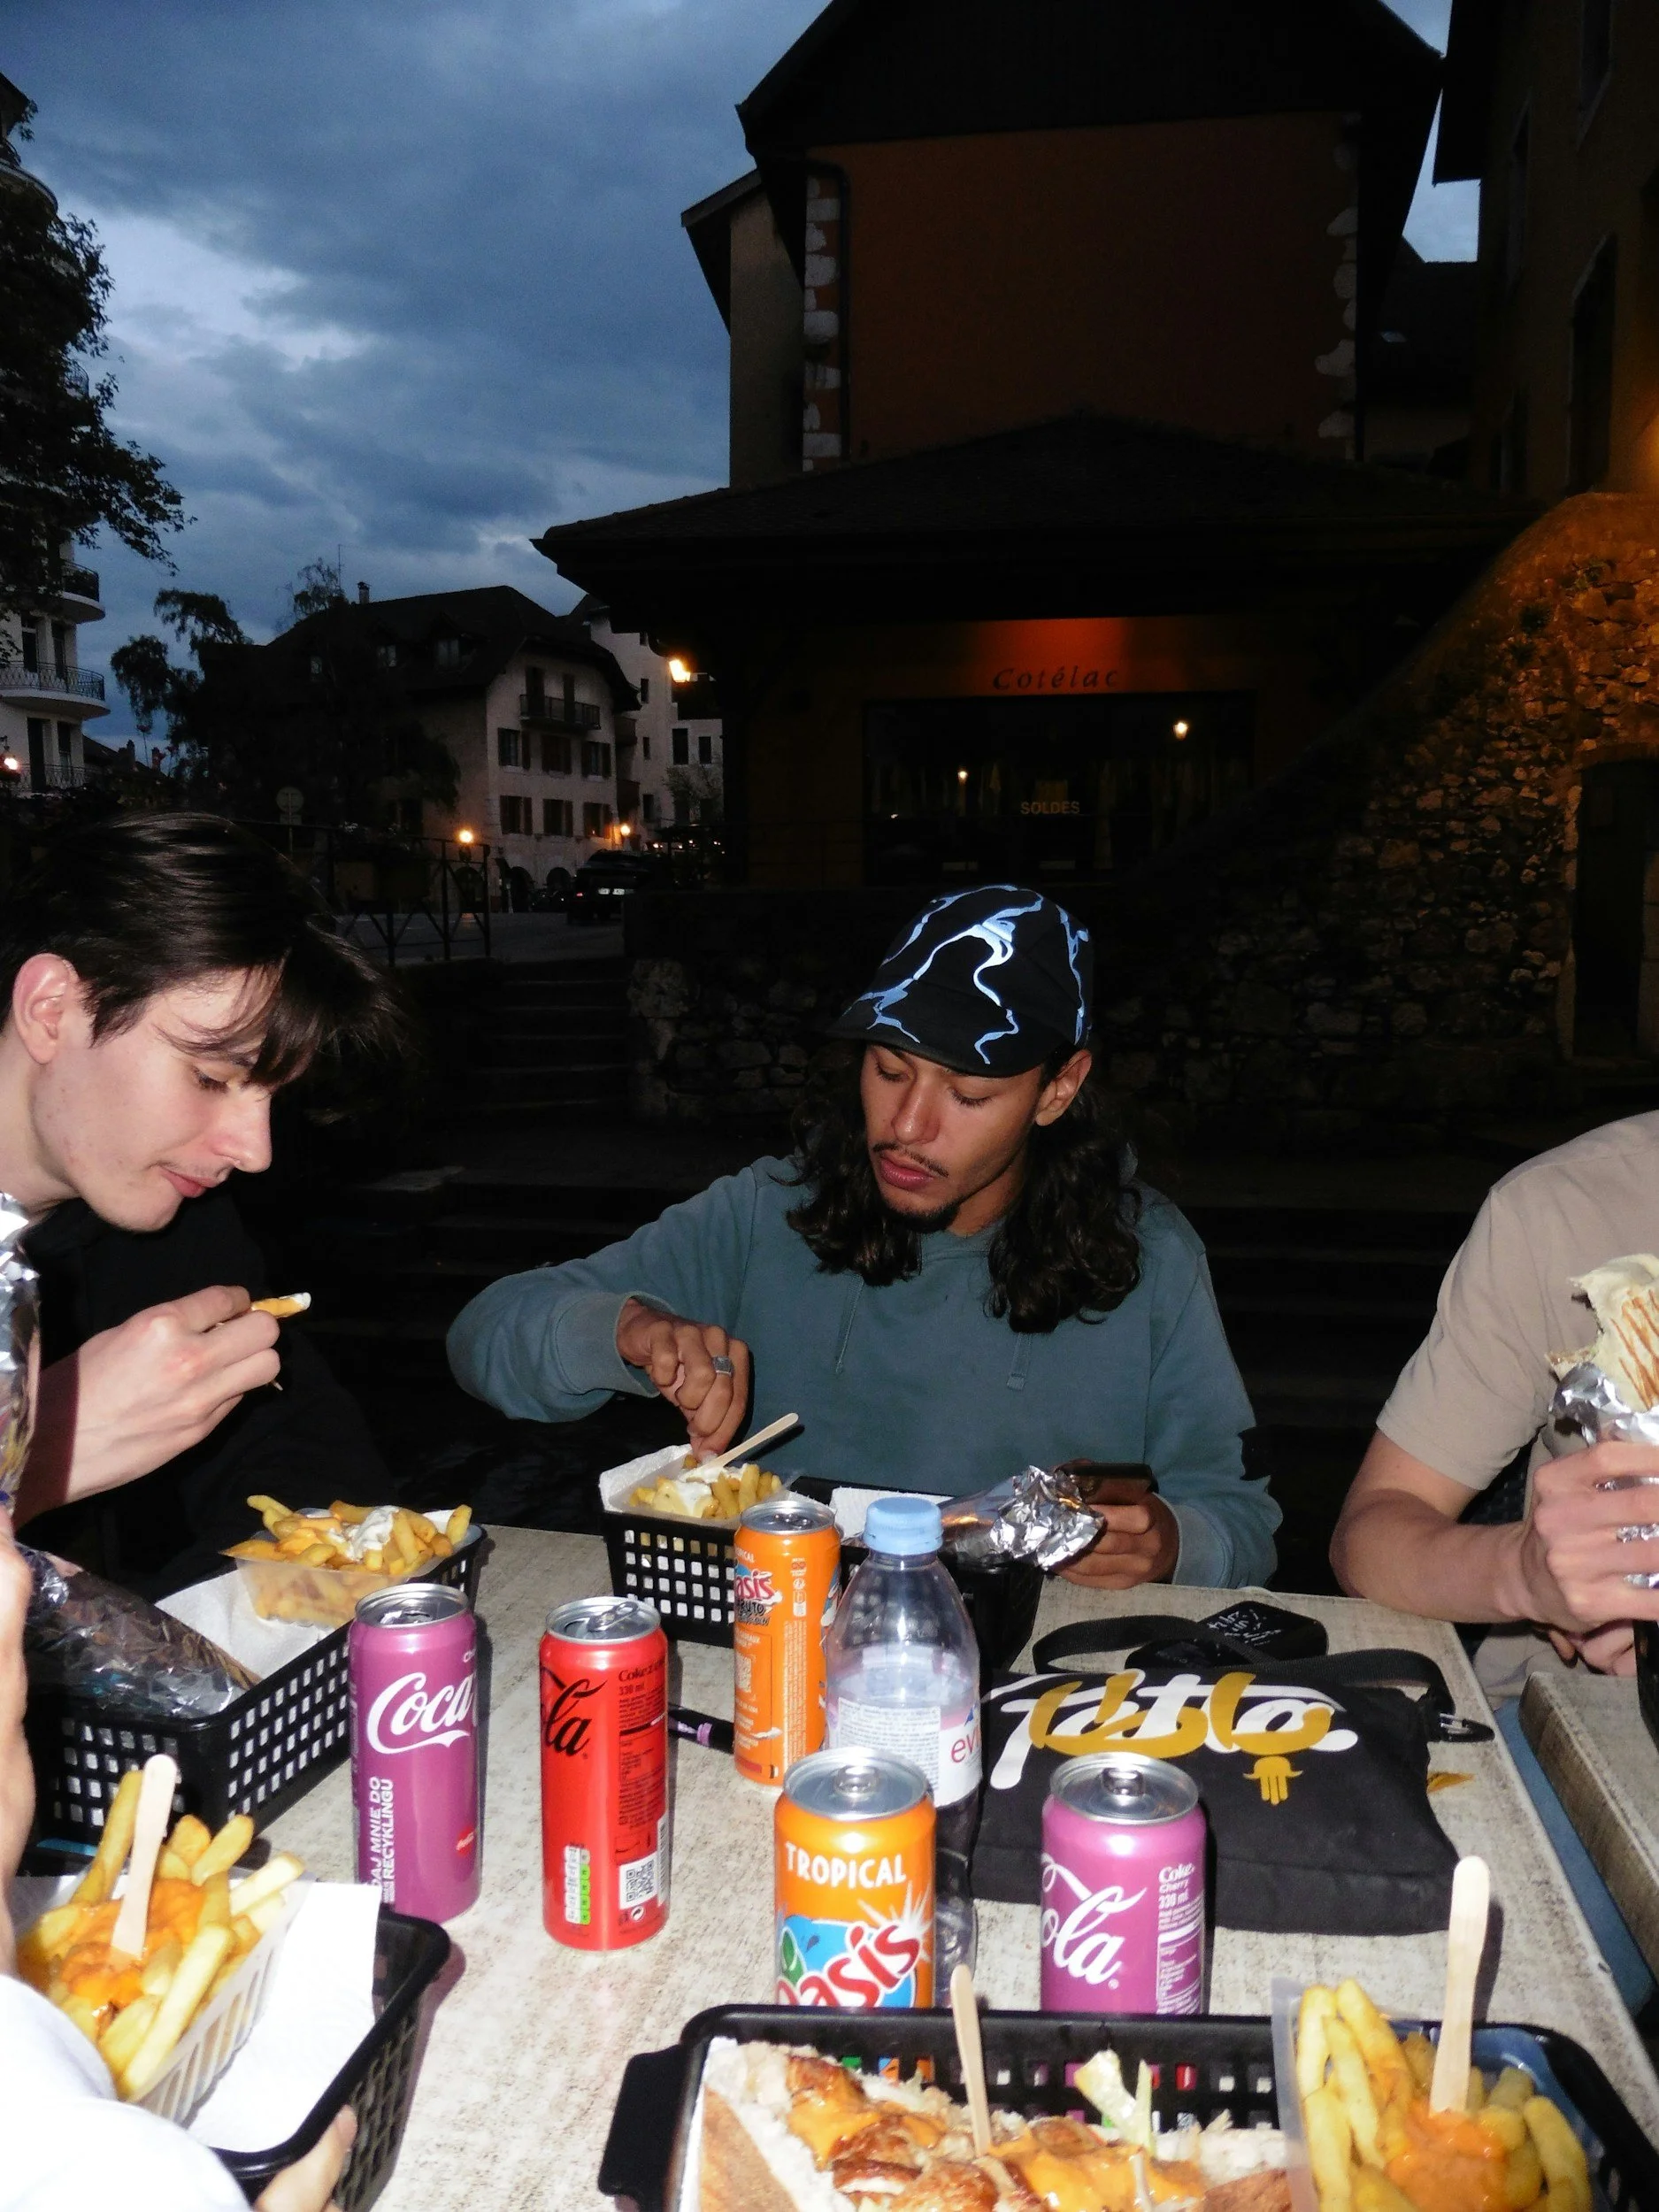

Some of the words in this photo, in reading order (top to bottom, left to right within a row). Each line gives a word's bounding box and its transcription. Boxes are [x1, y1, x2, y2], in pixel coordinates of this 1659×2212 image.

[992, 665, 1119, 691] Cotélac
[1020, 800, 1080, 815] SOLDES
[734, 1569, 775, 1601] asis
[541, 1663, 608, 1756] la
[368, 1776, 381, 1804] DO
[369, 1807, 382, 1854] MNIE
[380, 1778, 396, 1880] RECYKLINGU
[785, 1841, 907, 1890] TROPICAL
